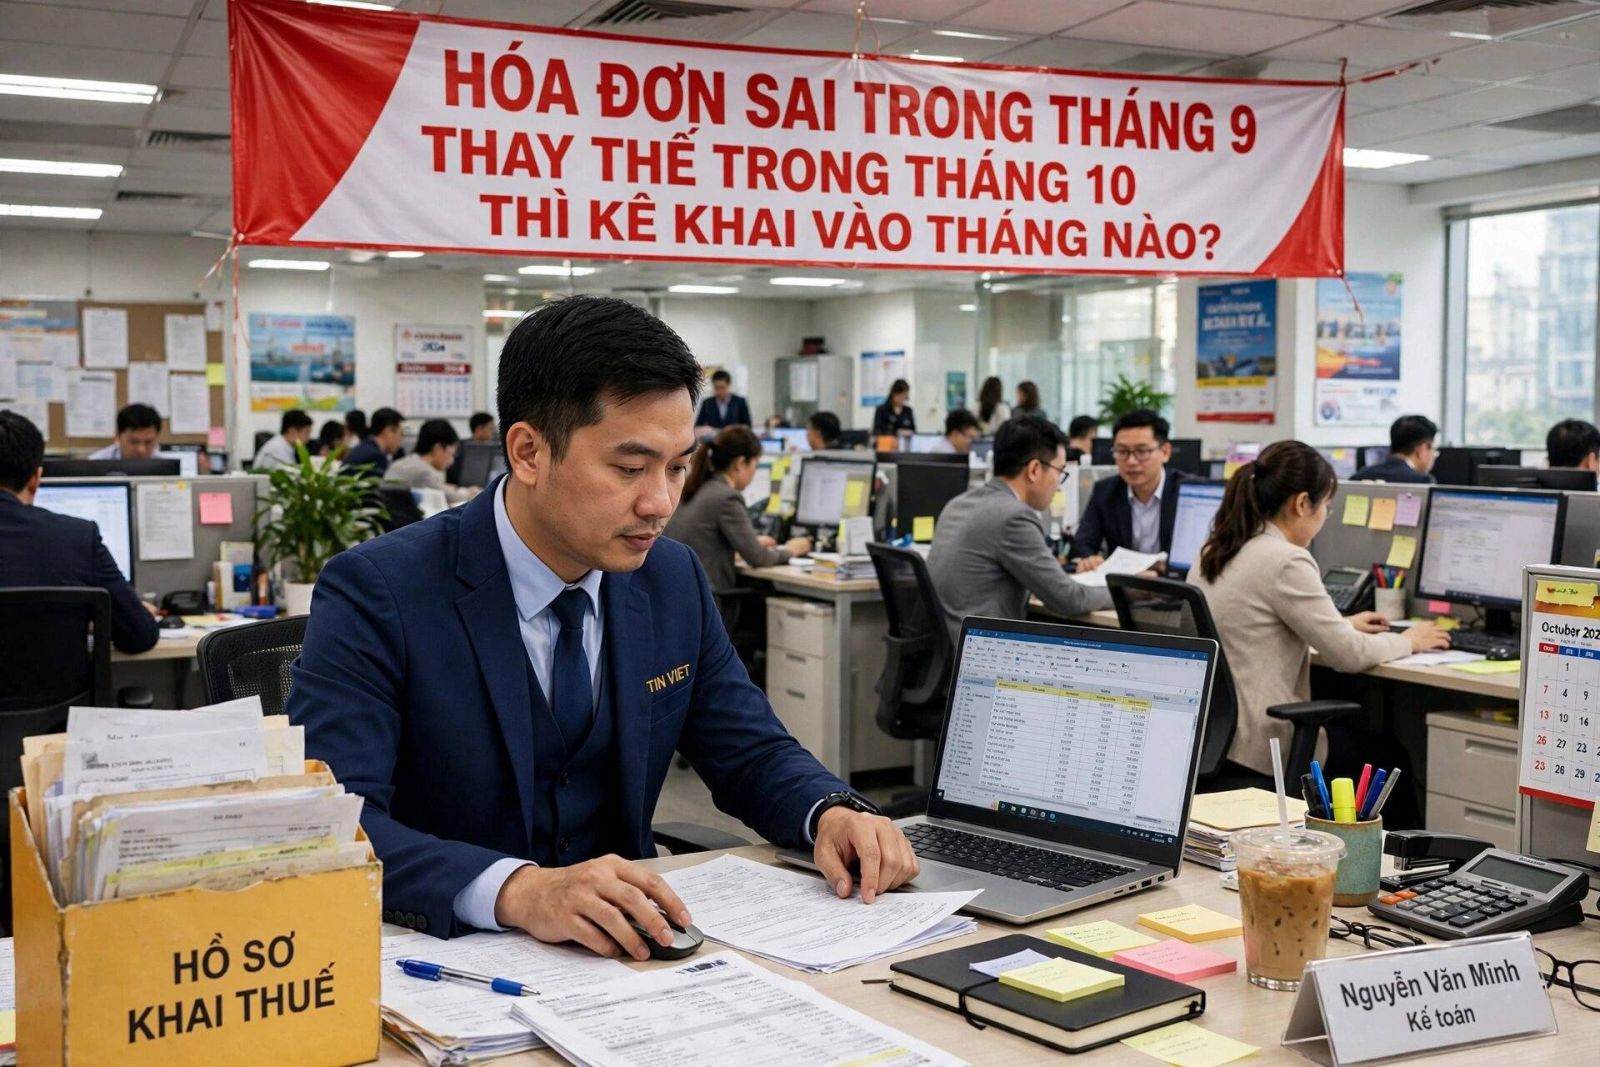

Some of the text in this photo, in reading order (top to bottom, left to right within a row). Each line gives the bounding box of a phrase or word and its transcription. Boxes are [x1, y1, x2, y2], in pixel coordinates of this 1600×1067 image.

[445, 41, 1257, 154] HÓA ĐƠN SAI TRONG THÁNG 9
[421, 126, 1136, 206] THAY THẾ TRONG THÁNG 10
[480, 188, 1221, 260] THÌ KÊ KHAI VÀO THÁNG NÀO?
[646, 663, 690, 692] TIN VIET
[1565, 662, 1570, 672] 1
[1543, 685, 1589, 700] 7 4 9
[1540, 710, 1549, 720] 13
[1579, 716, 1589, 727] 16
[1536, 734, 1547, 745] 26
[1576, 742, 1587, 753] 23
[1534, 760, 1546, 771] 23
[1574, 768, 1585, 779] 29
[173, 930, 295, 985] HỒ SƠ
[1340, 958, 1521, 1012] Nguyễn Văn Minh
[128, 961, 335, 1044] KHAI THUẾ
[1406, 1004, 1476, 1033] Kế toán
